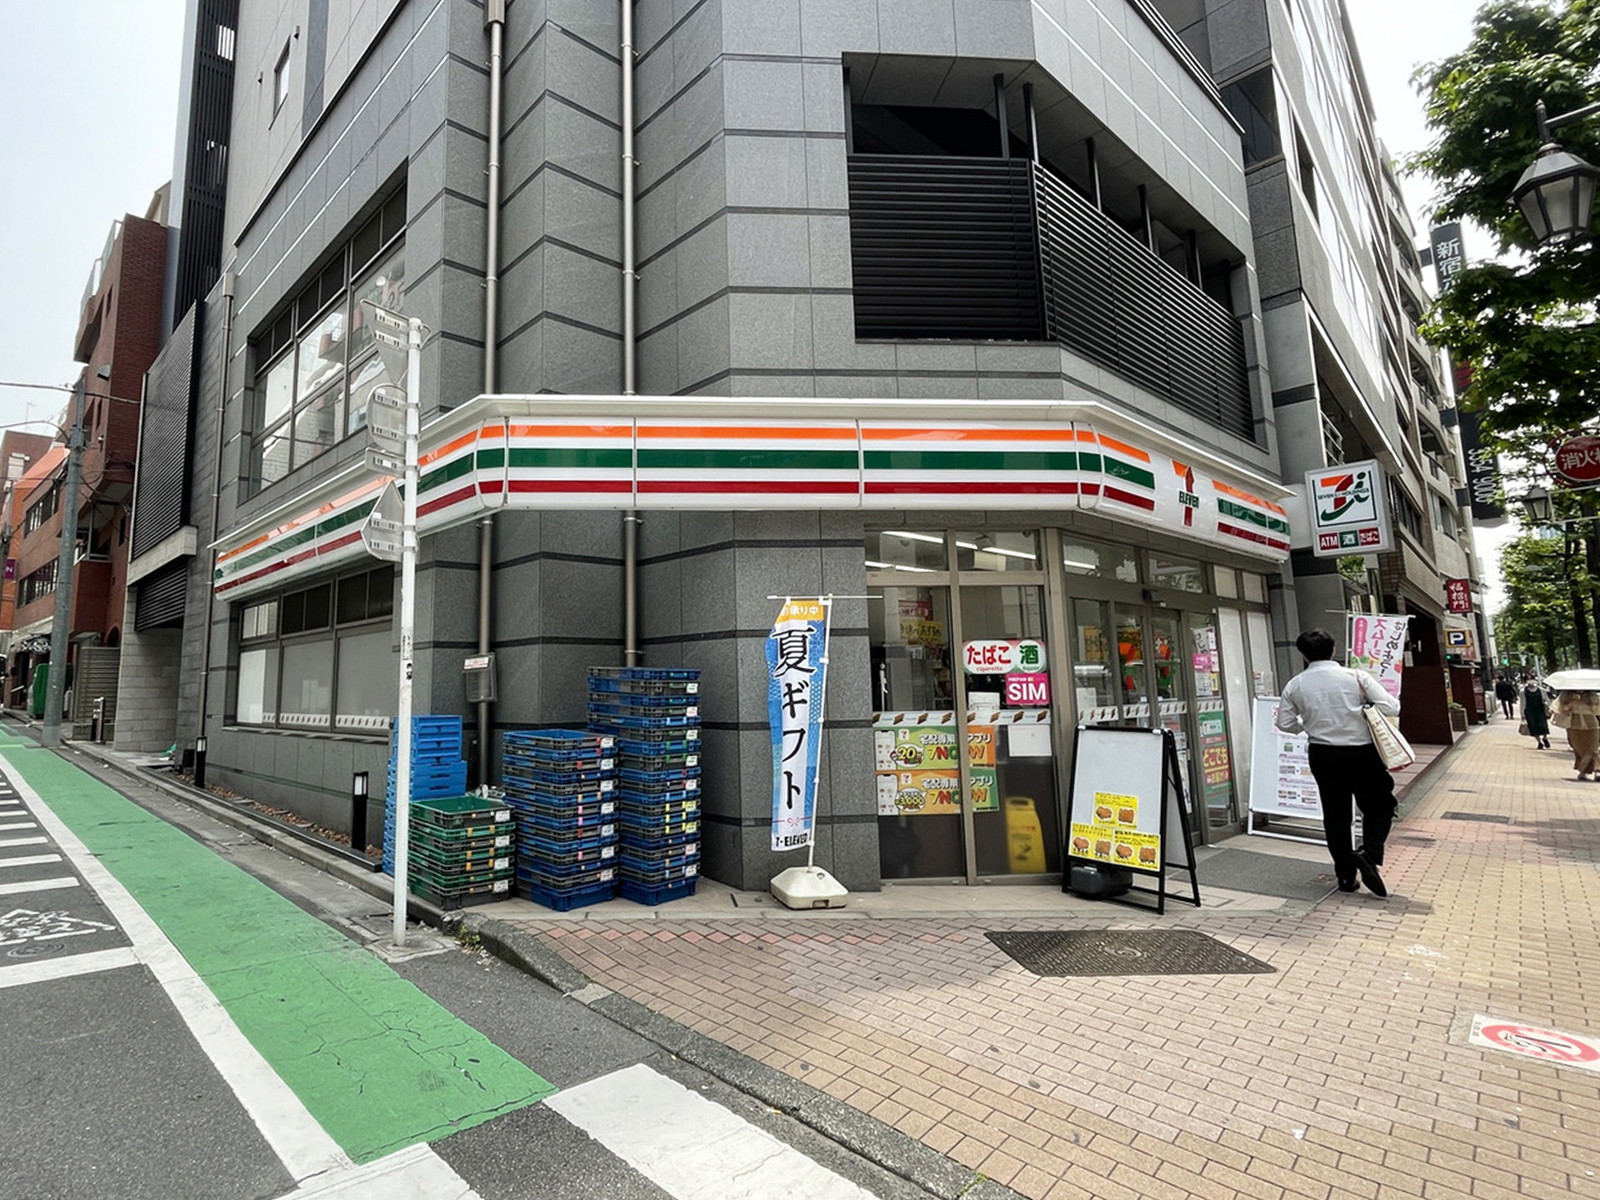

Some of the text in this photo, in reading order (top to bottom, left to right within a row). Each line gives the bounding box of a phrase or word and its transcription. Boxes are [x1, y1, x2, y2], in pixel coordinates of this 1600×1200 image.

[1320, 535, 1338, 548] ATM
[1342, 533, 1356, 545] 酒
[1360, 531, 1379, 543] たばこ
[1449, 632, 1464, 645] P
[967, 645, 1012, 665] たばこ
[1019, 644, 1039, 665] 酒
[1008, 683, 1047, 701] SIM
[771, 627, 815, 810] 夏ギフト
